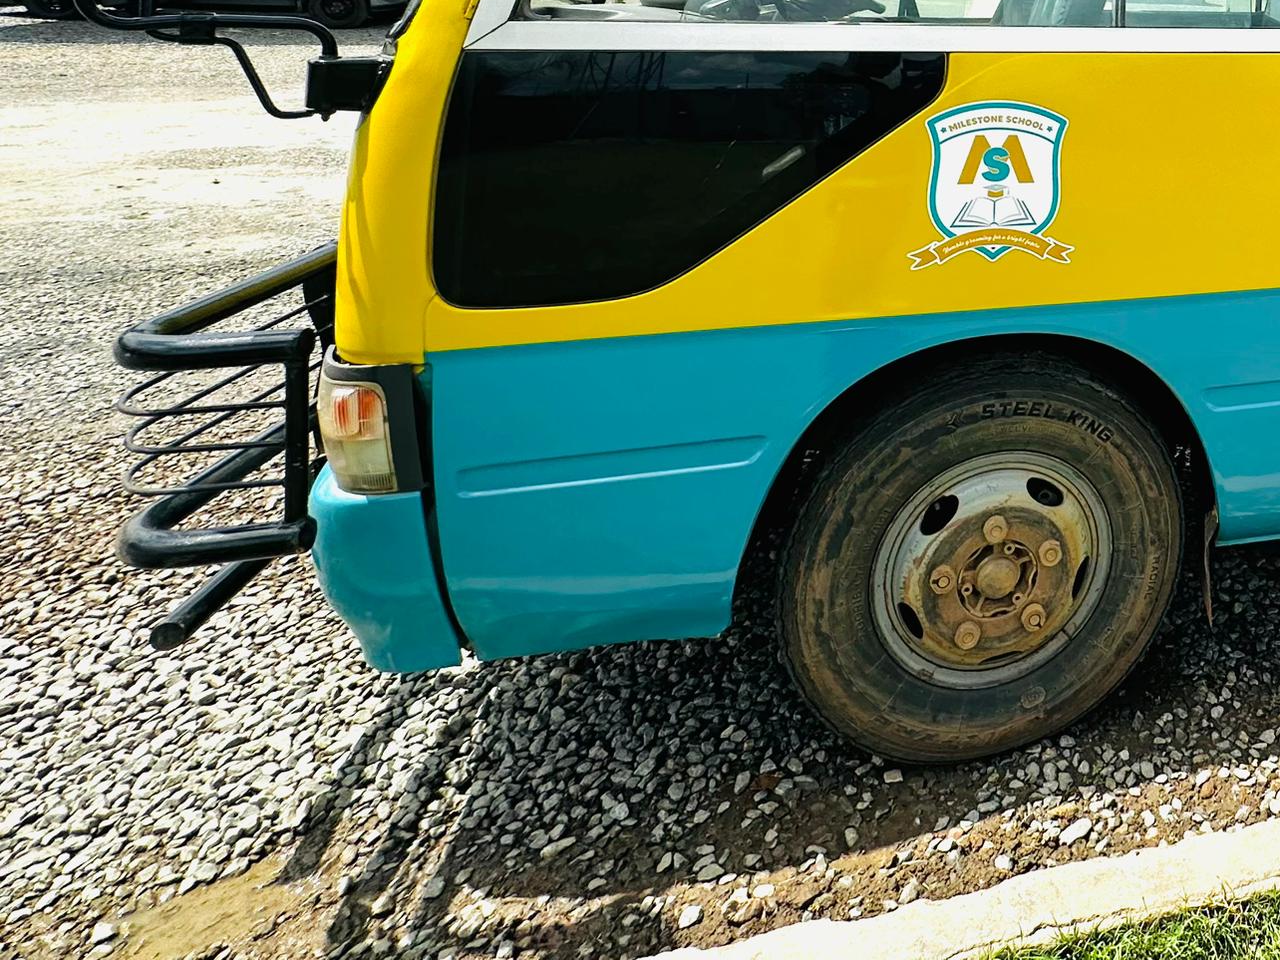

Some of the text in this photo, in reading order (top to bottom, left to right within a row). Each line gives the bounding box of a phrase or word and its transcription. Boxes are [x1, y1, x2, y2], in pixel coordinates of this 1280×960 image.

[948, 115, 1044, 132] MILESTONE SCHOOL
[980, 401, 1115, 443] STEEL KING
[1143, 552, 1162, 601] RADIAL
